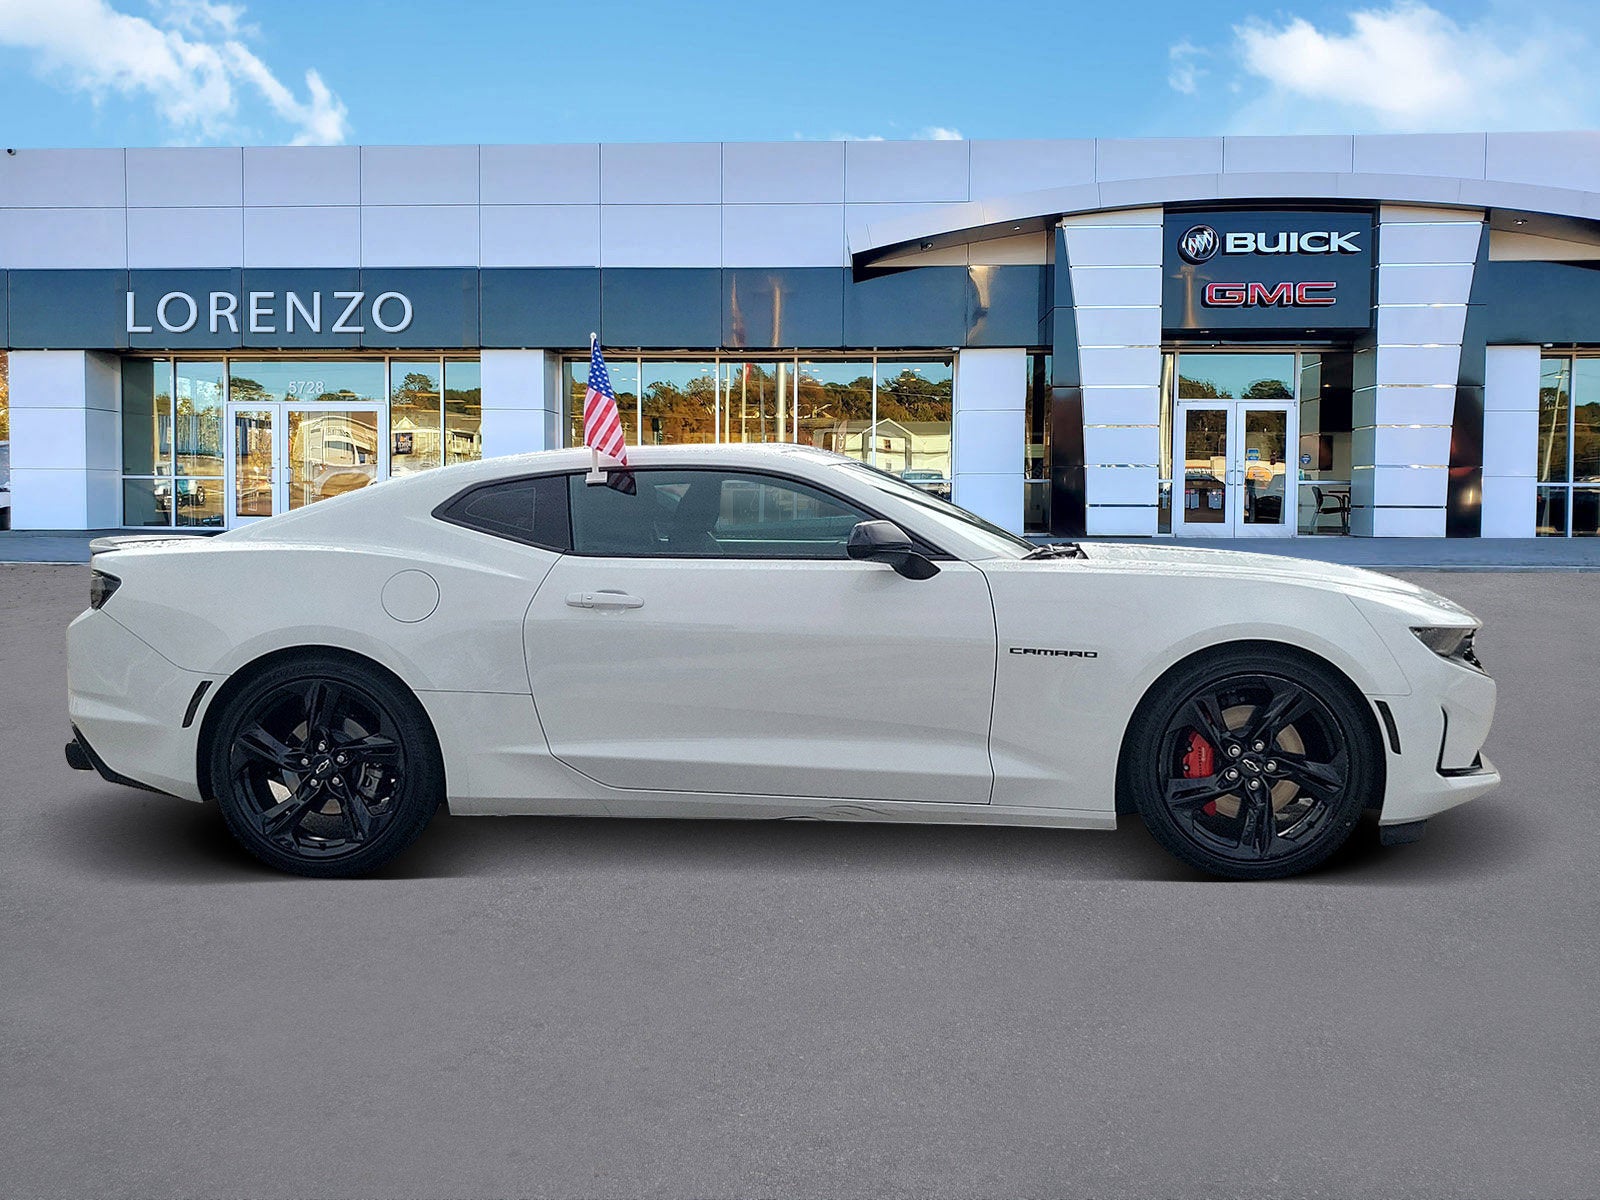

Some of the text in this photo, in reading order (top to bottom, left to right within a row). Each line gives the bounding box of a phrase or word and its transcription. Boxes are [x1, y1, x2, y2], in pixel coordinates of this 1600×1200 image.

[1225, 231, 1362, 253] BUICK
[1205, 282, 1337, 305] GMC
[126, 291, 414, 334] LORENZO
[288, 381, 325, 394] 5728
[1009, 647, 1098, 658] CAMARO
